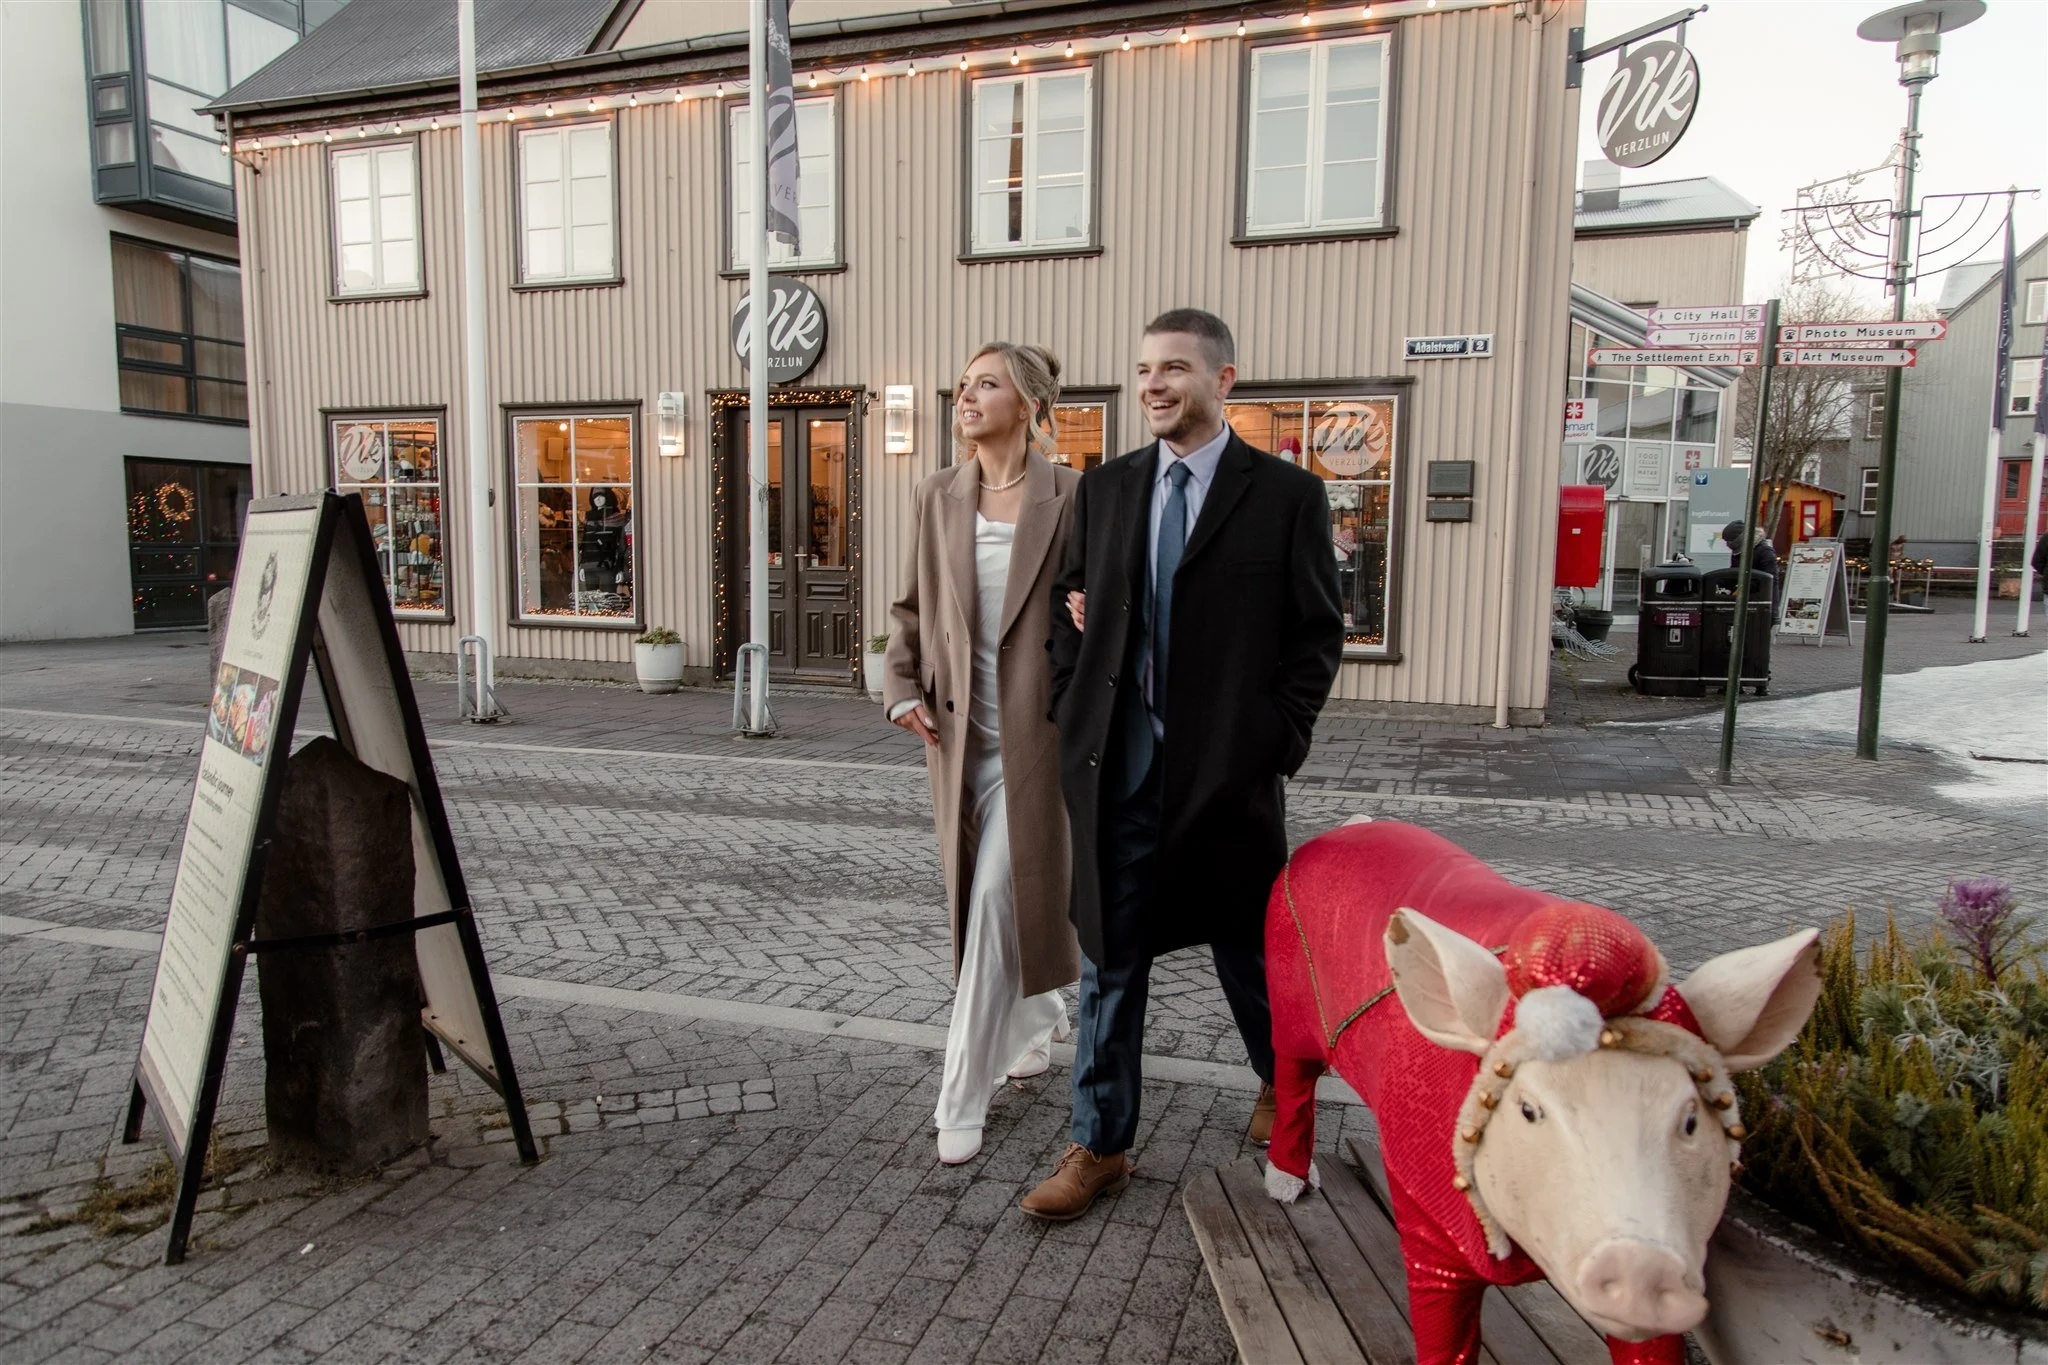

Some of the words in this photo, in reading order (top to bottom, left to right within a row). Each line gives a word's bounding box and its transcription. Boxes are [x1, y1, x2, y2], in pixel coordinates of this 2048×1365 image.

[1614, 131, 1670, 158] VERZLUN
[1673, 312, 1702, 322] City
[1710, 310, 1738, 319] Hall
[1688, 332, 1736, 343] Tjörnin
[1805, 329, 1847, 339] Photo
[1856, 327, 1916, 337] Museum
[1414, 341, 1460, 353] Aðalstræti
[1475, 341, 1485, 351] 2
[767, 356, 803, 368] RZLUN
[1611, 353, 1632, 362] The
[1636, 353, 1703, 362] Settlement
[1708, 353, 1734, 362] Exh.
[1802, 352, 1823, 361] Art
[1830, 352, 1885, 362] Museum
[1329, 458, 1370, 466] VERZLUN
